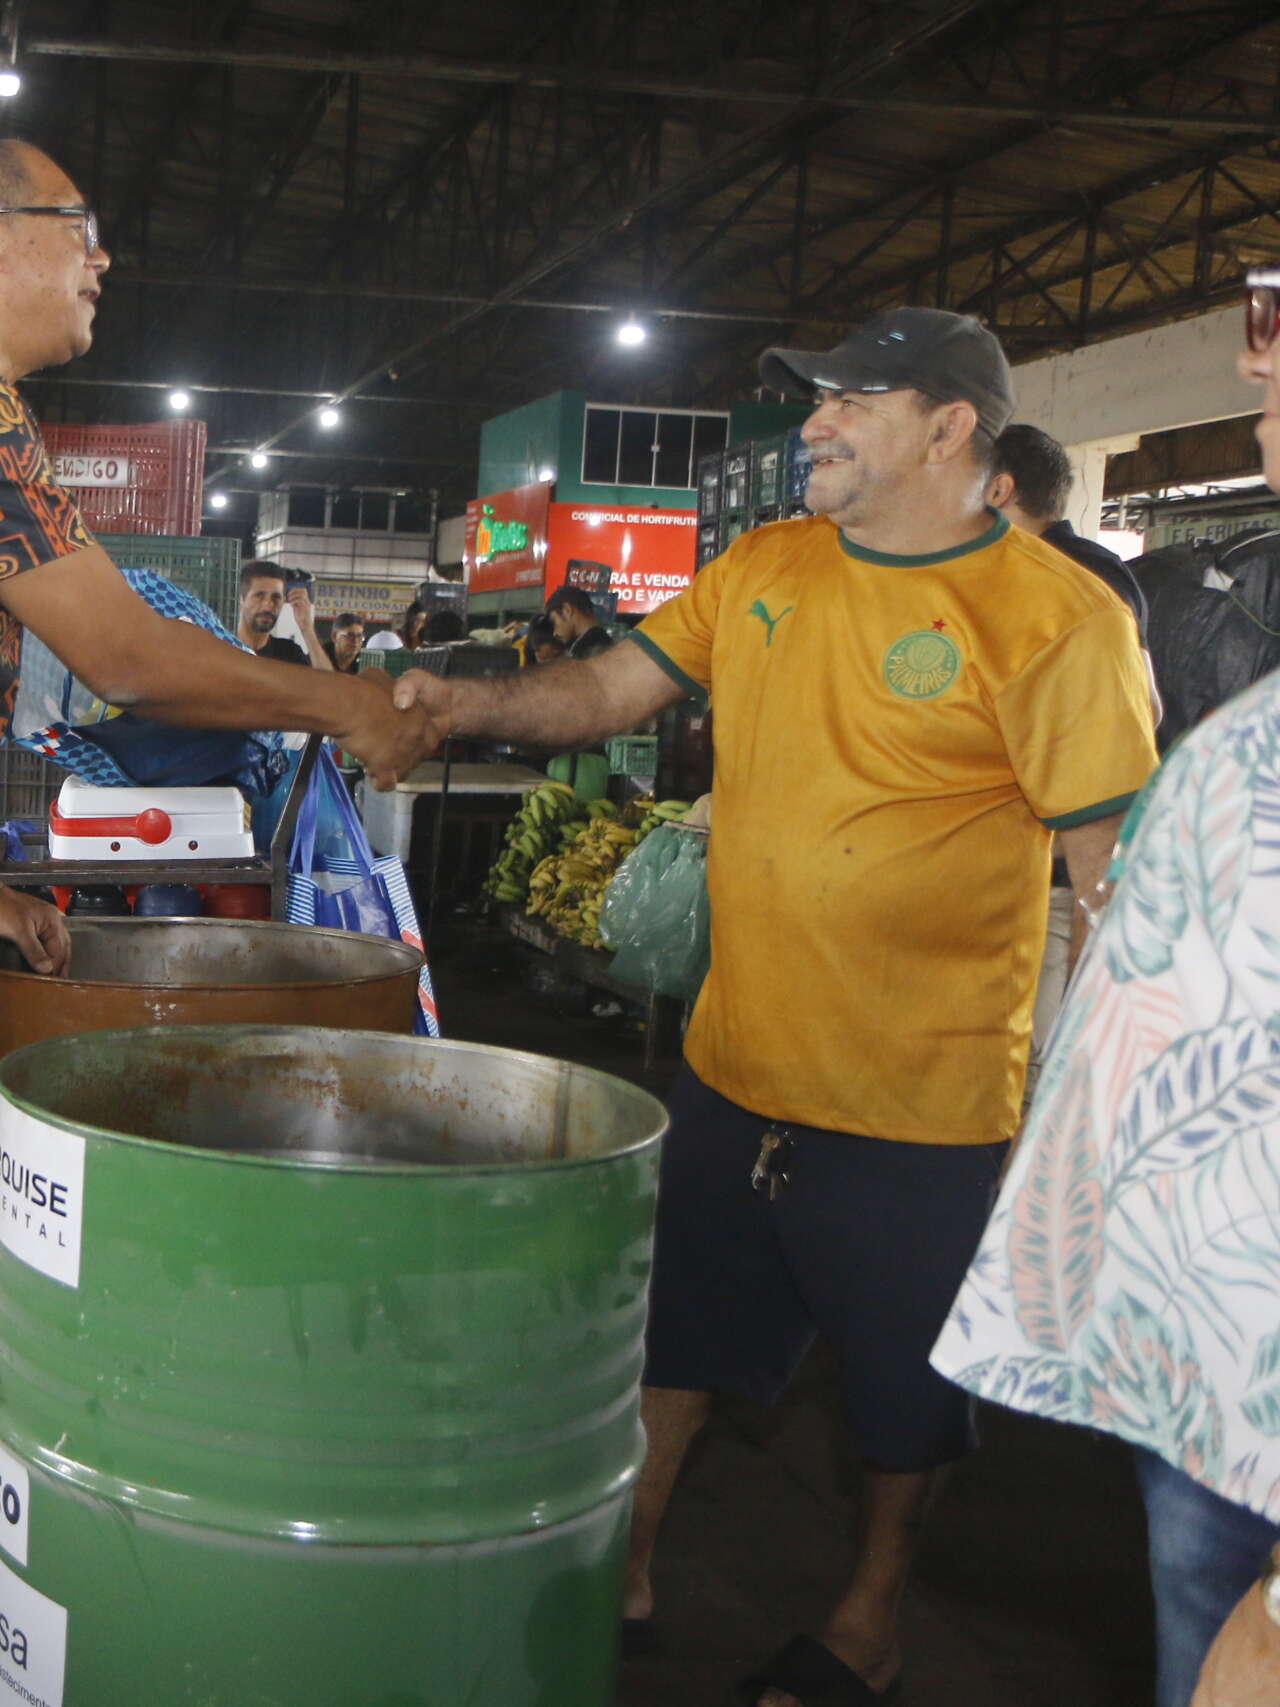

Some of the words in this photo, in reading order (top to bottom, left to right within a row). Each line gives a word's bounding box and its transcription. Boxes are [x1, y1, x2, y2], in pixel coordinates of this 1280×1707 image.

[627, 514, 641, 524] DE
[632, 573, 641, 586] E
[643, 573, 690, 588] VENDA
[636, 590, 646, 602] E
